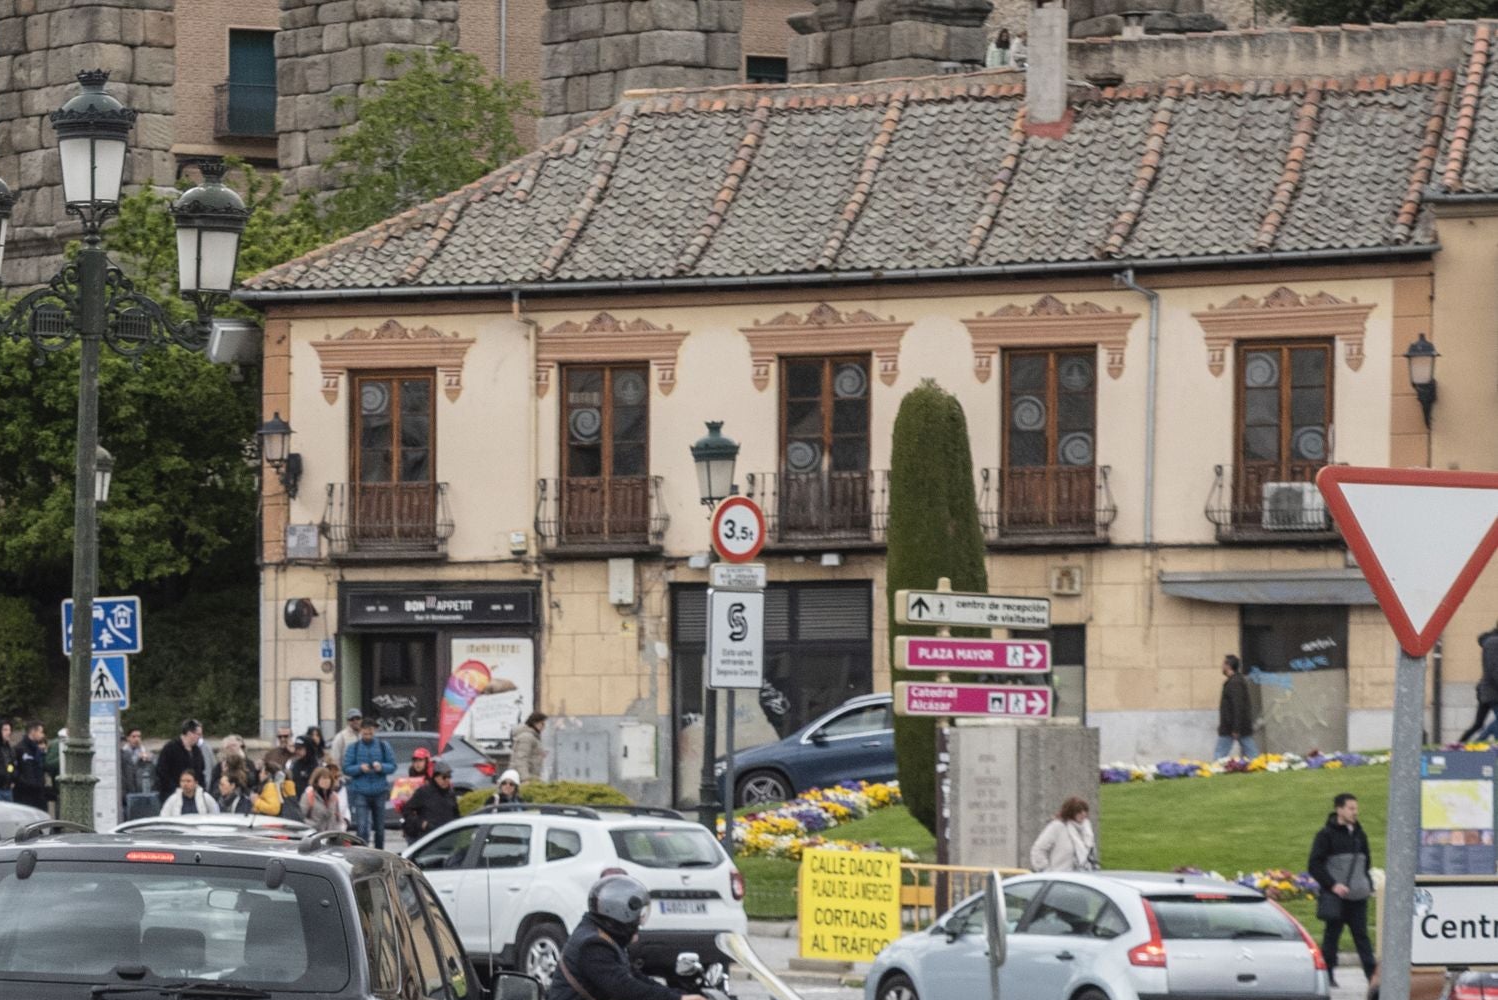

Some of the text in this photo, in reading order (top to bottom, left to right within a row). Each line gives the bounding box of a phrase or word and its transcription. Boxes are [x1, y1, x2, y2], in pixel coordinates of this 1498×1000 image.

[723, 519, 754, 541] 3,5t
[404, 600, 473, 612] BON APPETIT
[955, 600, 1046, 613] centro de recepción
[987, 613, 1046, 625] de visitantes
[918, 647, 995, 661] PLAZA MAYOR
[910, 687, 958, 699] Catedral
[910, 699, 952, 711] Alcázar
[811, 855, 893, 878] CALLE DAOIZ Y
[812, 879, 893, 902] PLAZA DE LA MERCED
[814, 907, 887, 930] CORTADAS
[812, 934, 828, 952] AL
